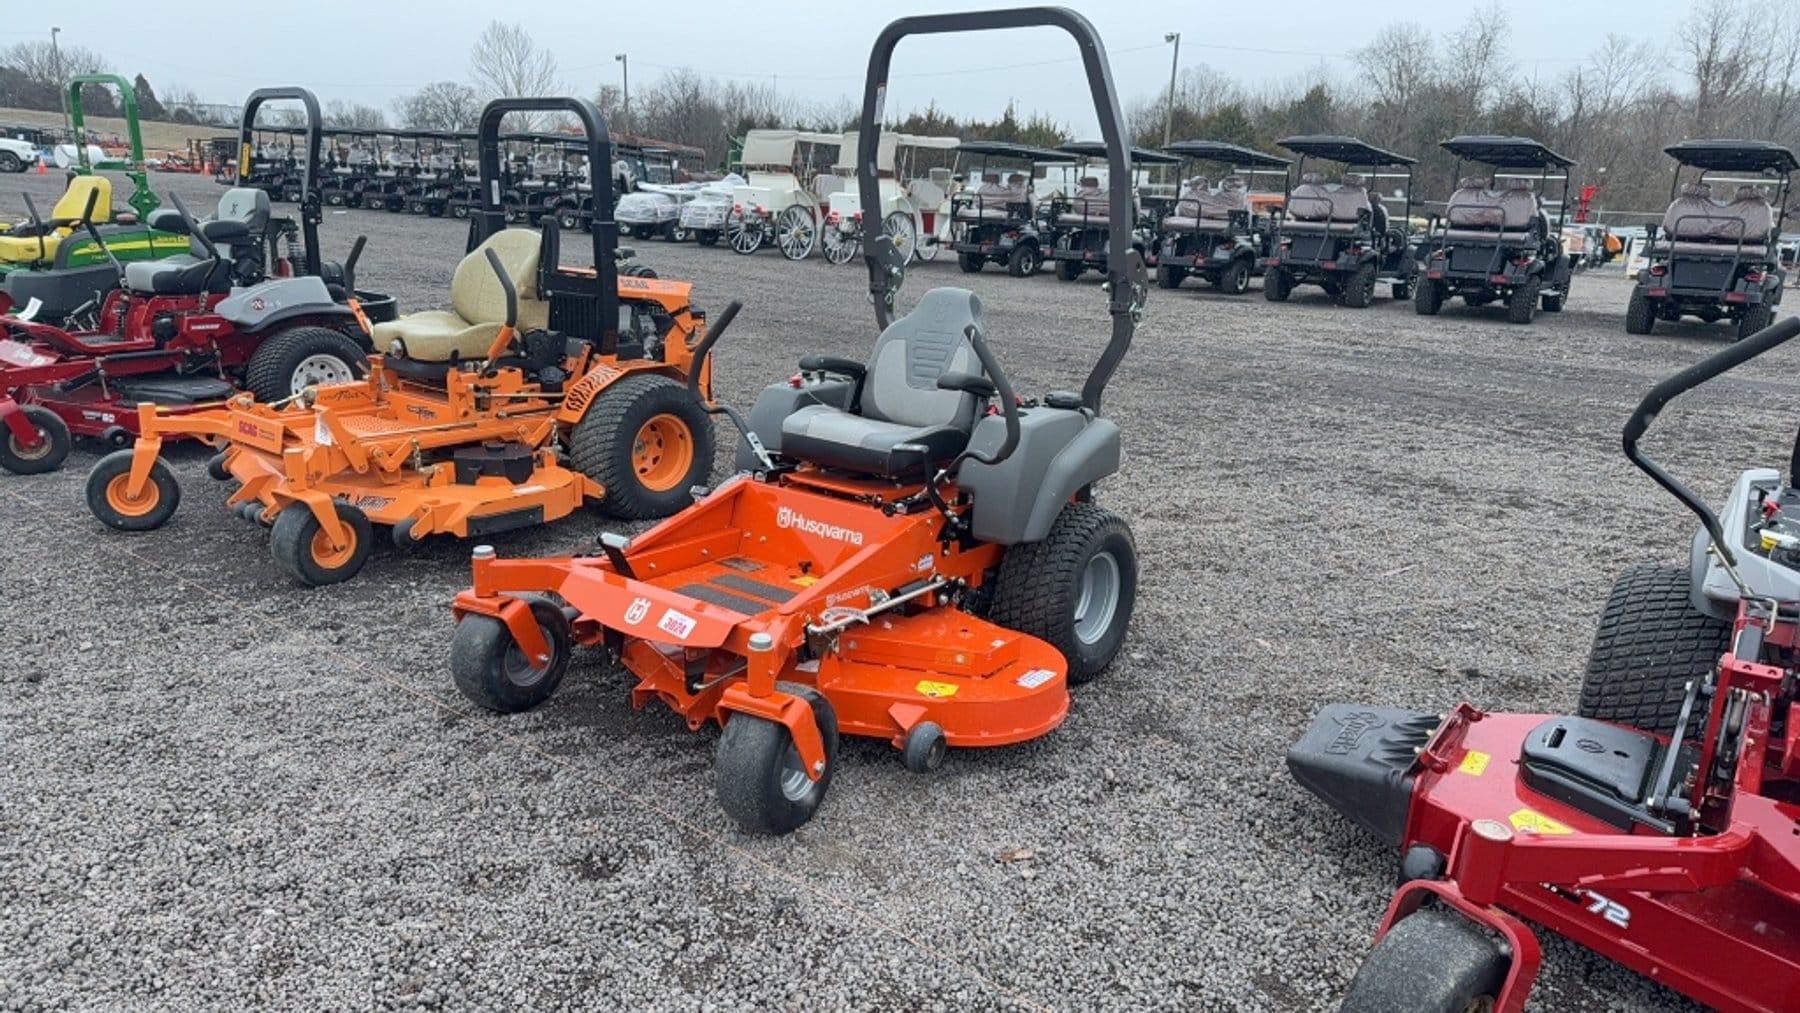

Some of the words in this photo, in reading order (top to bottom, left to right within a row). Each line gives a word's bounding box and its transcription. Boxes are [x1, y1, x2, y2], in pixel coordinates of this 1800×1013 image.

[238, 420, 258, 438] SCAG
[790, 511, 864, 545] Husqvarna
[1586, 889, 1631, 929] 72
